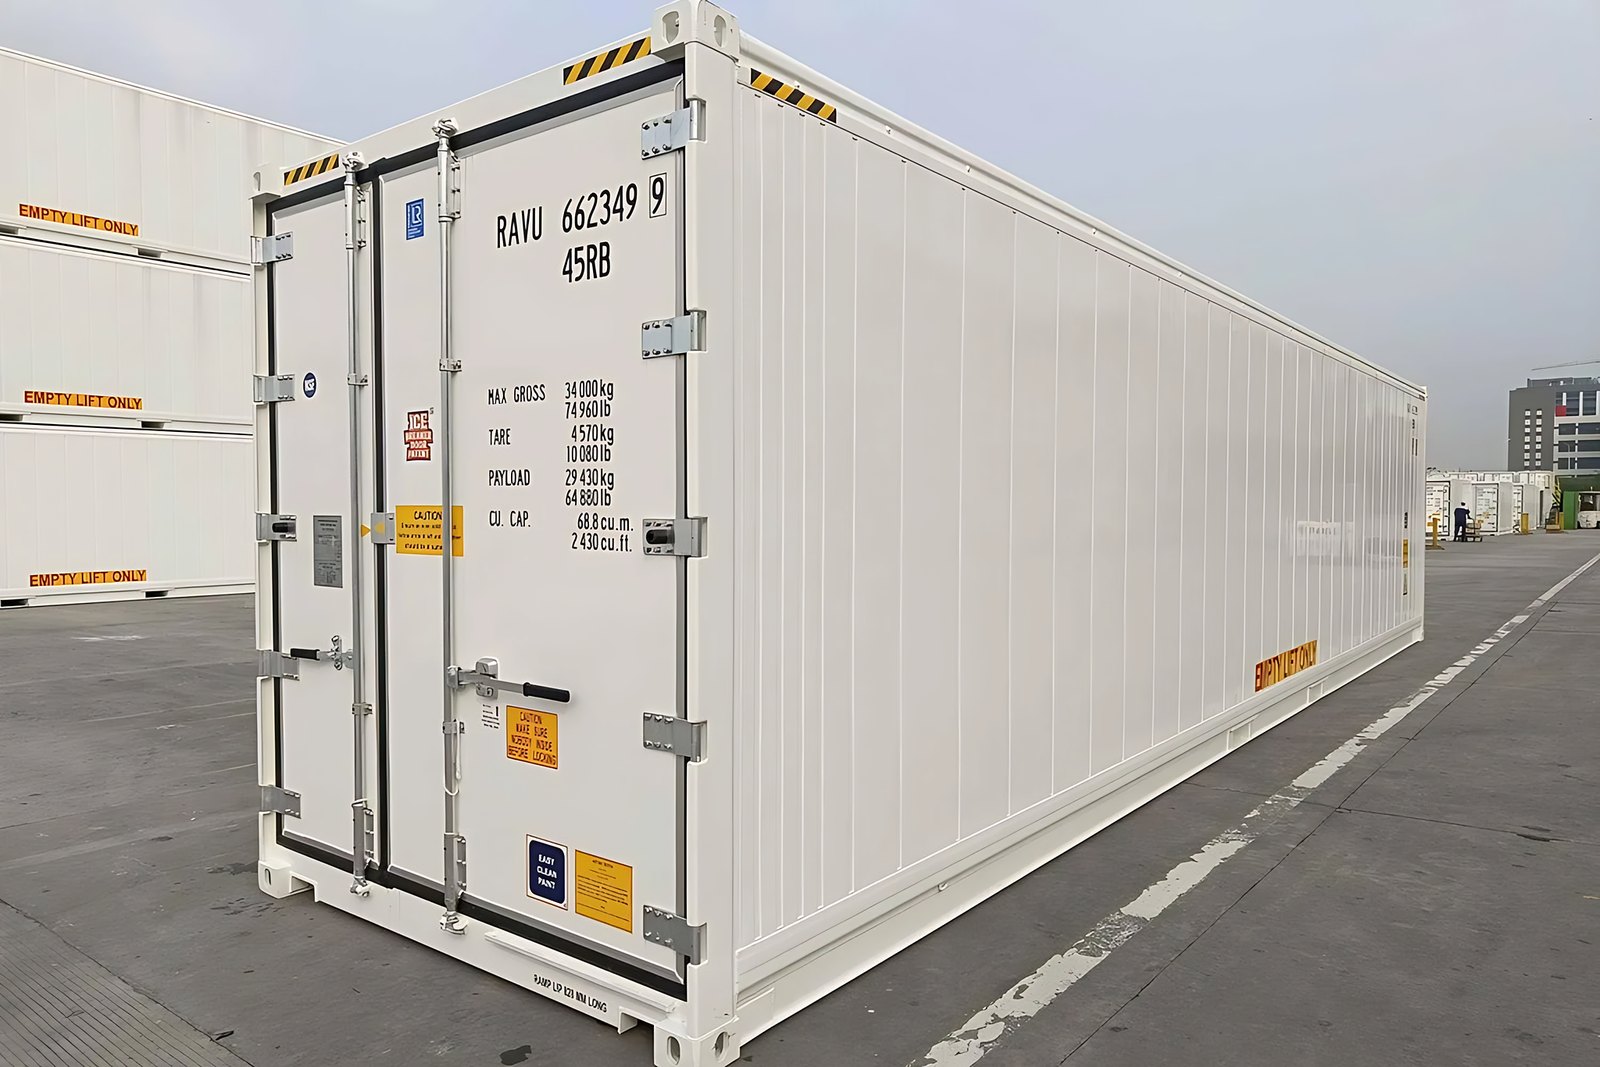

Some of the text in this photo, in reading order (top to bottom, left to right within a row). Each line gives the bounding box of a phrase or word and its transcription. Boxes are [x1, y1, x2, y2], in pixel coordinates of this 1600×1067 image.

[19, 203, 138, 237] EMPTY LIFT ONLY
[497, 177, 664, 248] RAVU 662349 9
[562, 241, 611, 283] 45RB
[24, 390, 142, 410] EMPTY LIFT ONLY
[488, 387, 507, 405] MAX
[513, 384, 546, 403] GROSS
[409, 412, 428, 431] ICE
[488, 428, 511, 446] TARE
[488, 469, 531, 487] PAYLOAD
[510, 510, 531, 528] CAP.
[30, 569, 147, 587] EMPTY LIFT ONLY
[1255, 653, 1283, 693] EMPTY
[1299, 640, 1318, 670] ONLY
[538, 854, 556, 866] EASY
[536, 865, 558, 879] CLEAN
[588, 996, 608, 1013] LONG
